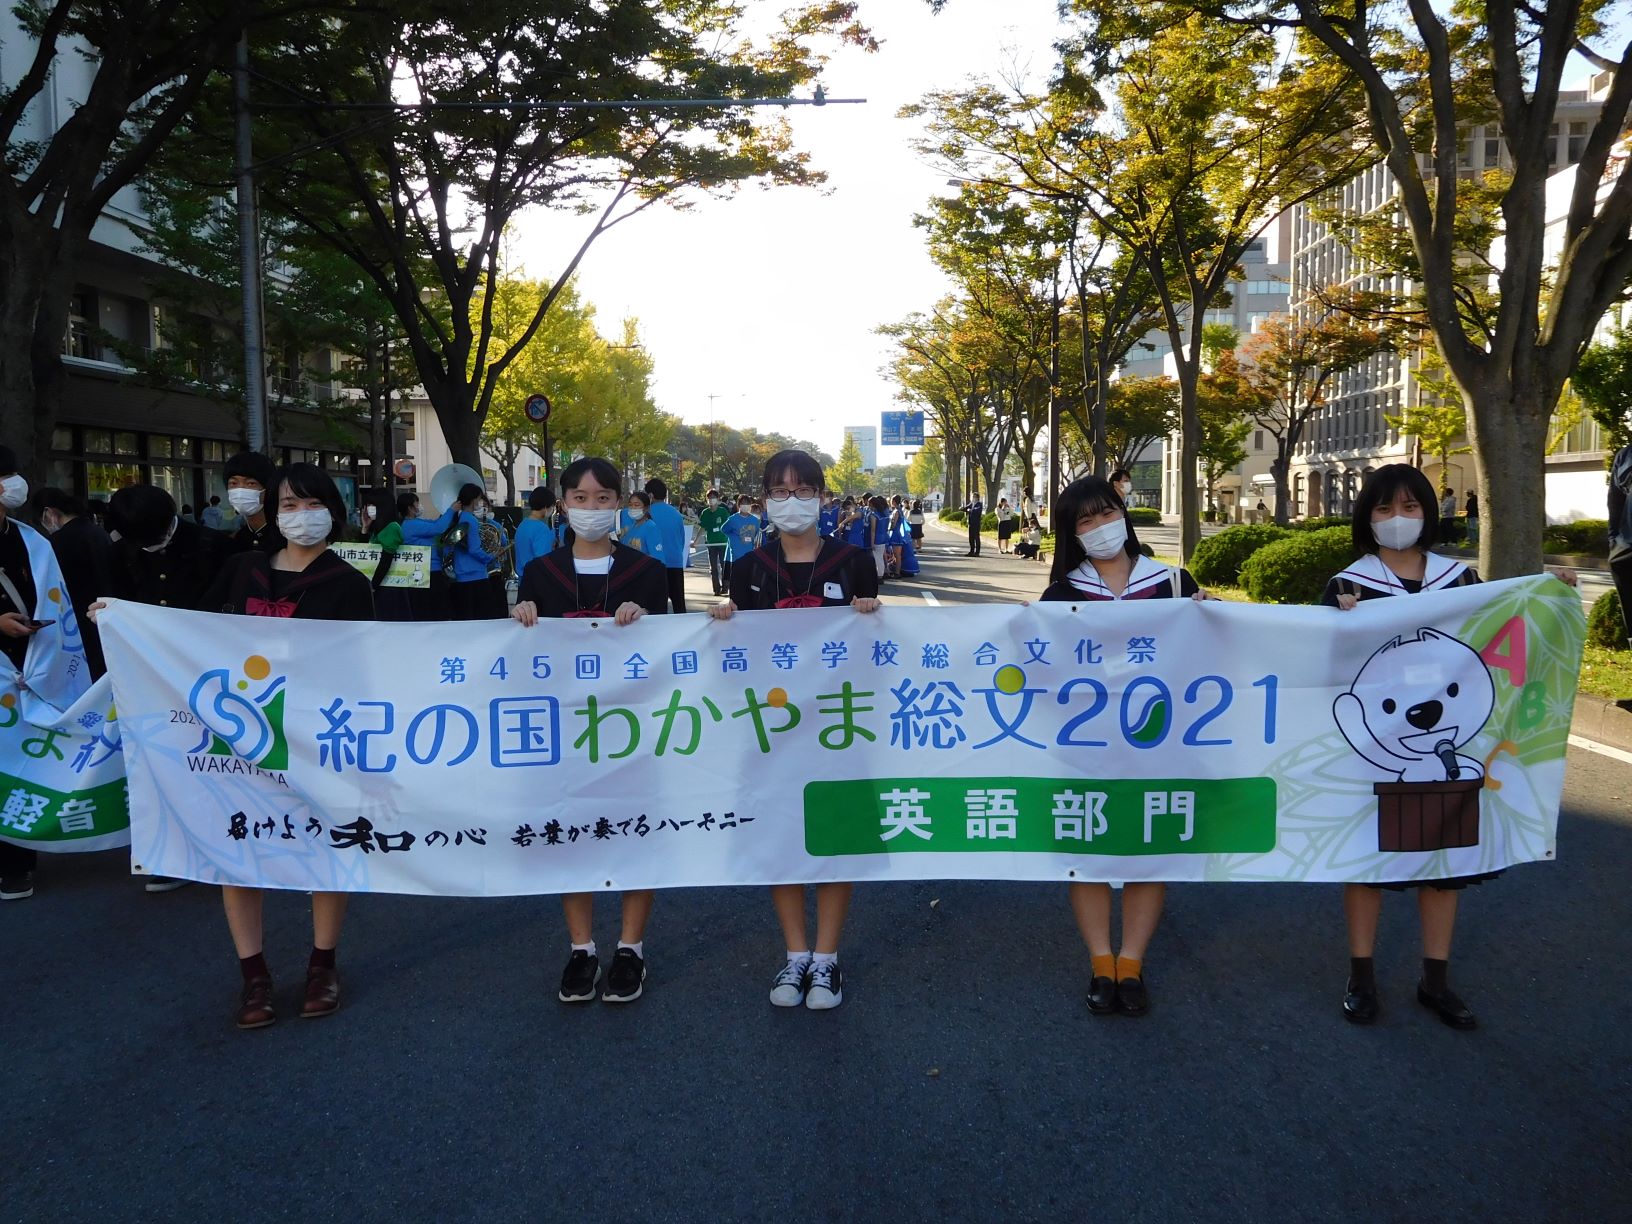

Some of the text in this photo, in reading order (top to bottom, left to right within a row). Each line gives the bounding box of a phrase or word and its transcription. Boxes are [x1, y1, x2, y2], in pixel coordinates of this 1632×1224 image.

[333, 548, 424, 563] 山市立有中学校
[438, 634, 1157, 685] 第45回全国高等学校総合文化祭
[1480, 615, 1526, 687] A
[1519, 680, 1547, 730] B
[878, 787, 1196, 844] 英語部門
